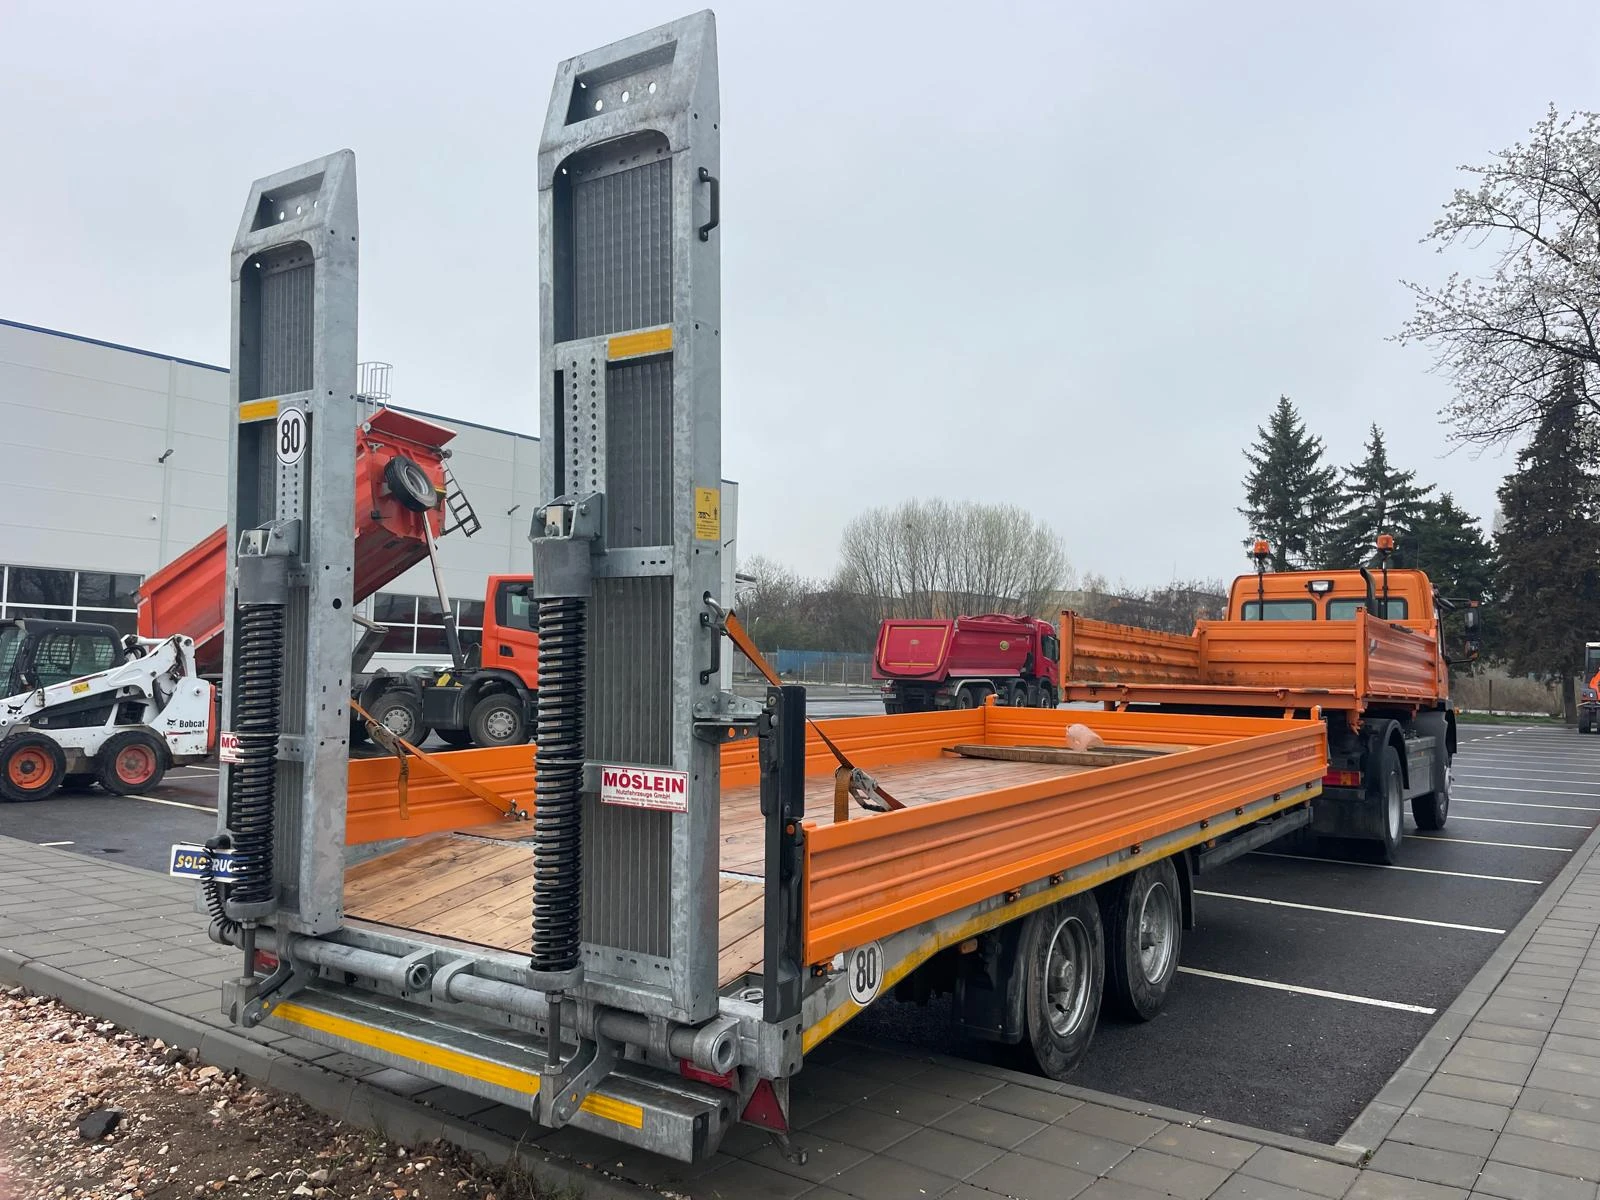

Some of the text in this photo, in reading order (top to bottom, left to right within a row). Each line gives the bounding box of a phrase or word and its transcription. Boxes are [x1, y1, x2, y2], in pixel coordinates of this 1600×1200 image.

[281, 418, 300, 454] 80
[179, 720, 205, 728] Bobcat
[603, 769, 684, 794] MÖSLEIN
[856, 947, 876, 993] 80
